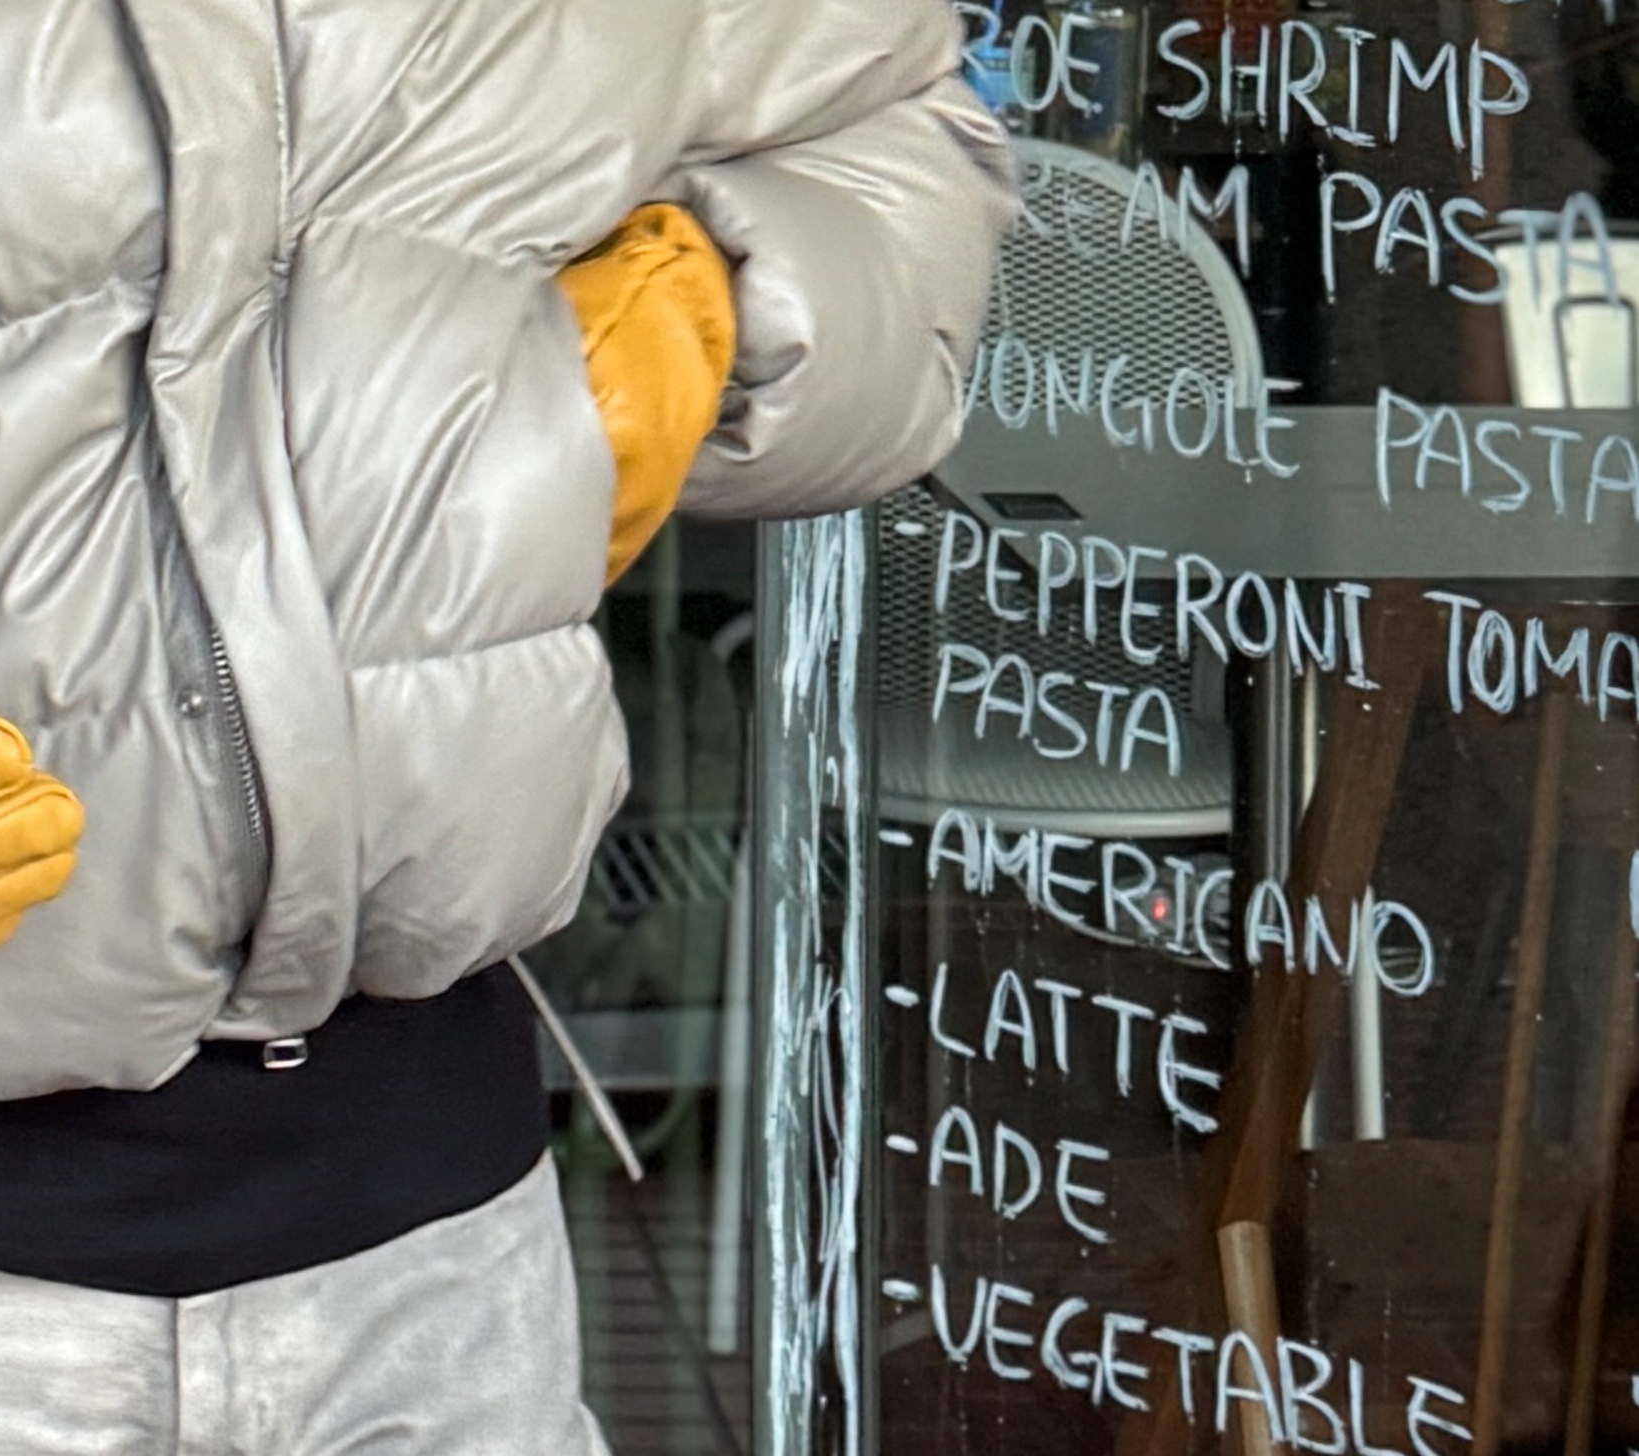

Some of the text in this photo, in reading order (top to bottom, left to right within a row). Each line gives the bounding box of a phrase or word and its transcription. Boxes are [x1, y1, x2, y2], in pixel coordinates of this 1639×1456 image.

[1157, 19, 1530, 176] SHRIMP
[1321, 172, 1620, 306] PASTA
[1376, 386, 1639, 526] PASTA
[933, 646, 1182, 777] PASTA
